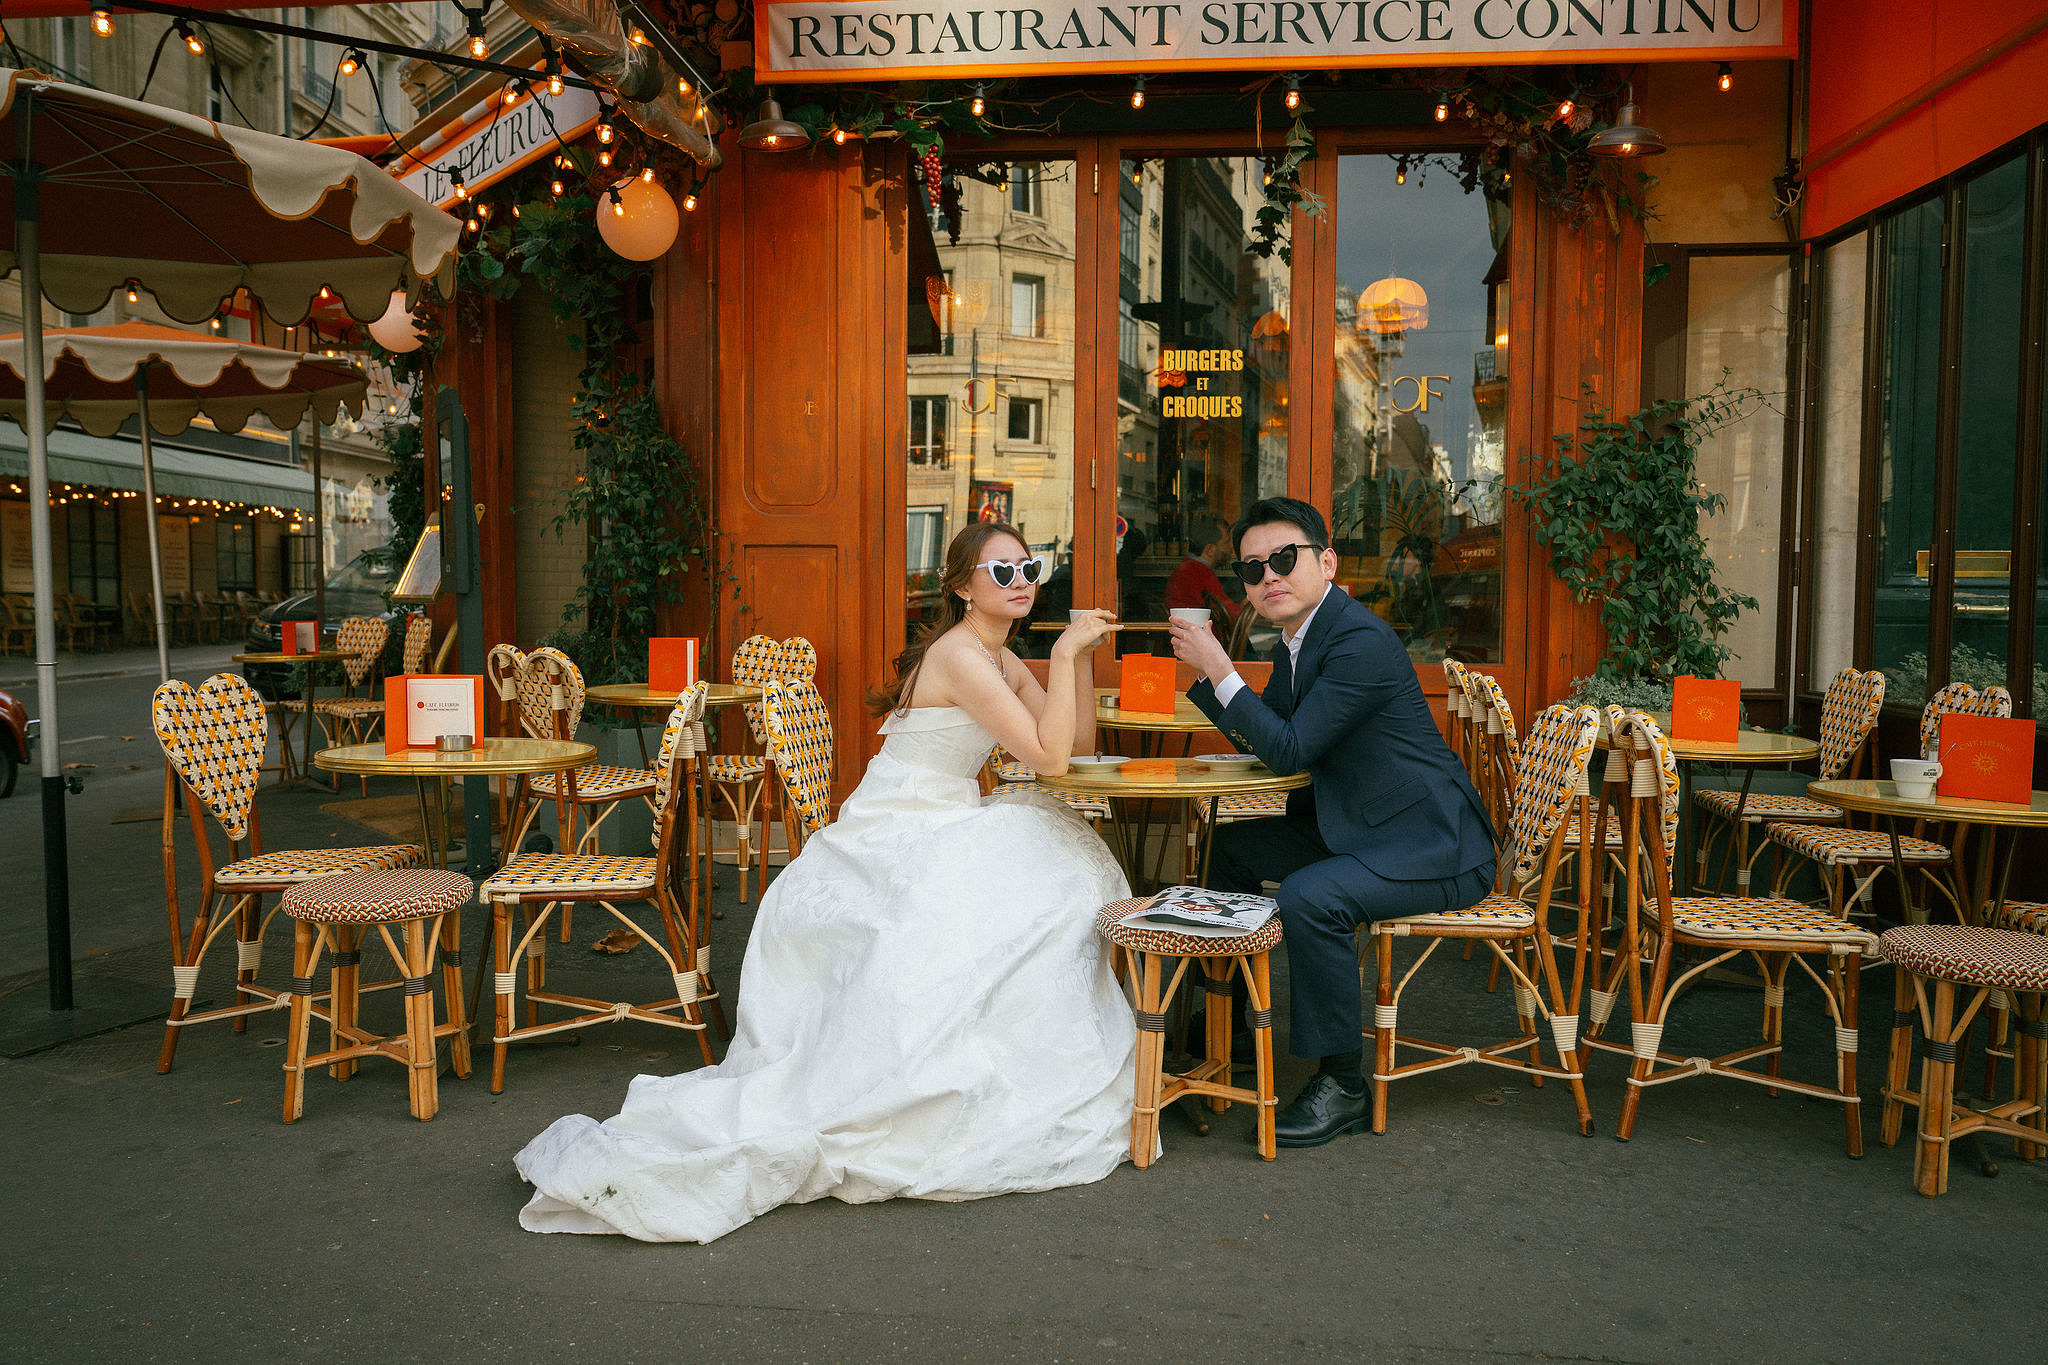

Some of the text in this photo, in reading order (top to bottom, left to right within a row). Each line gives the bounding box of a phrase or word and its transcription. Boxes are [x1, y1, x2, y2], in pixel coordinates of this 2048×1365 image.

[787, 0, 1762, 58] RESTAURANT SERVICE CONTINU
[458, 92, 556, 181] FLEURUS
[1163, 349, 1244, 372] BURGERS
[1196, 377, 1210, 391] ET
[1162, 395, 1243, 421] CROQUES
